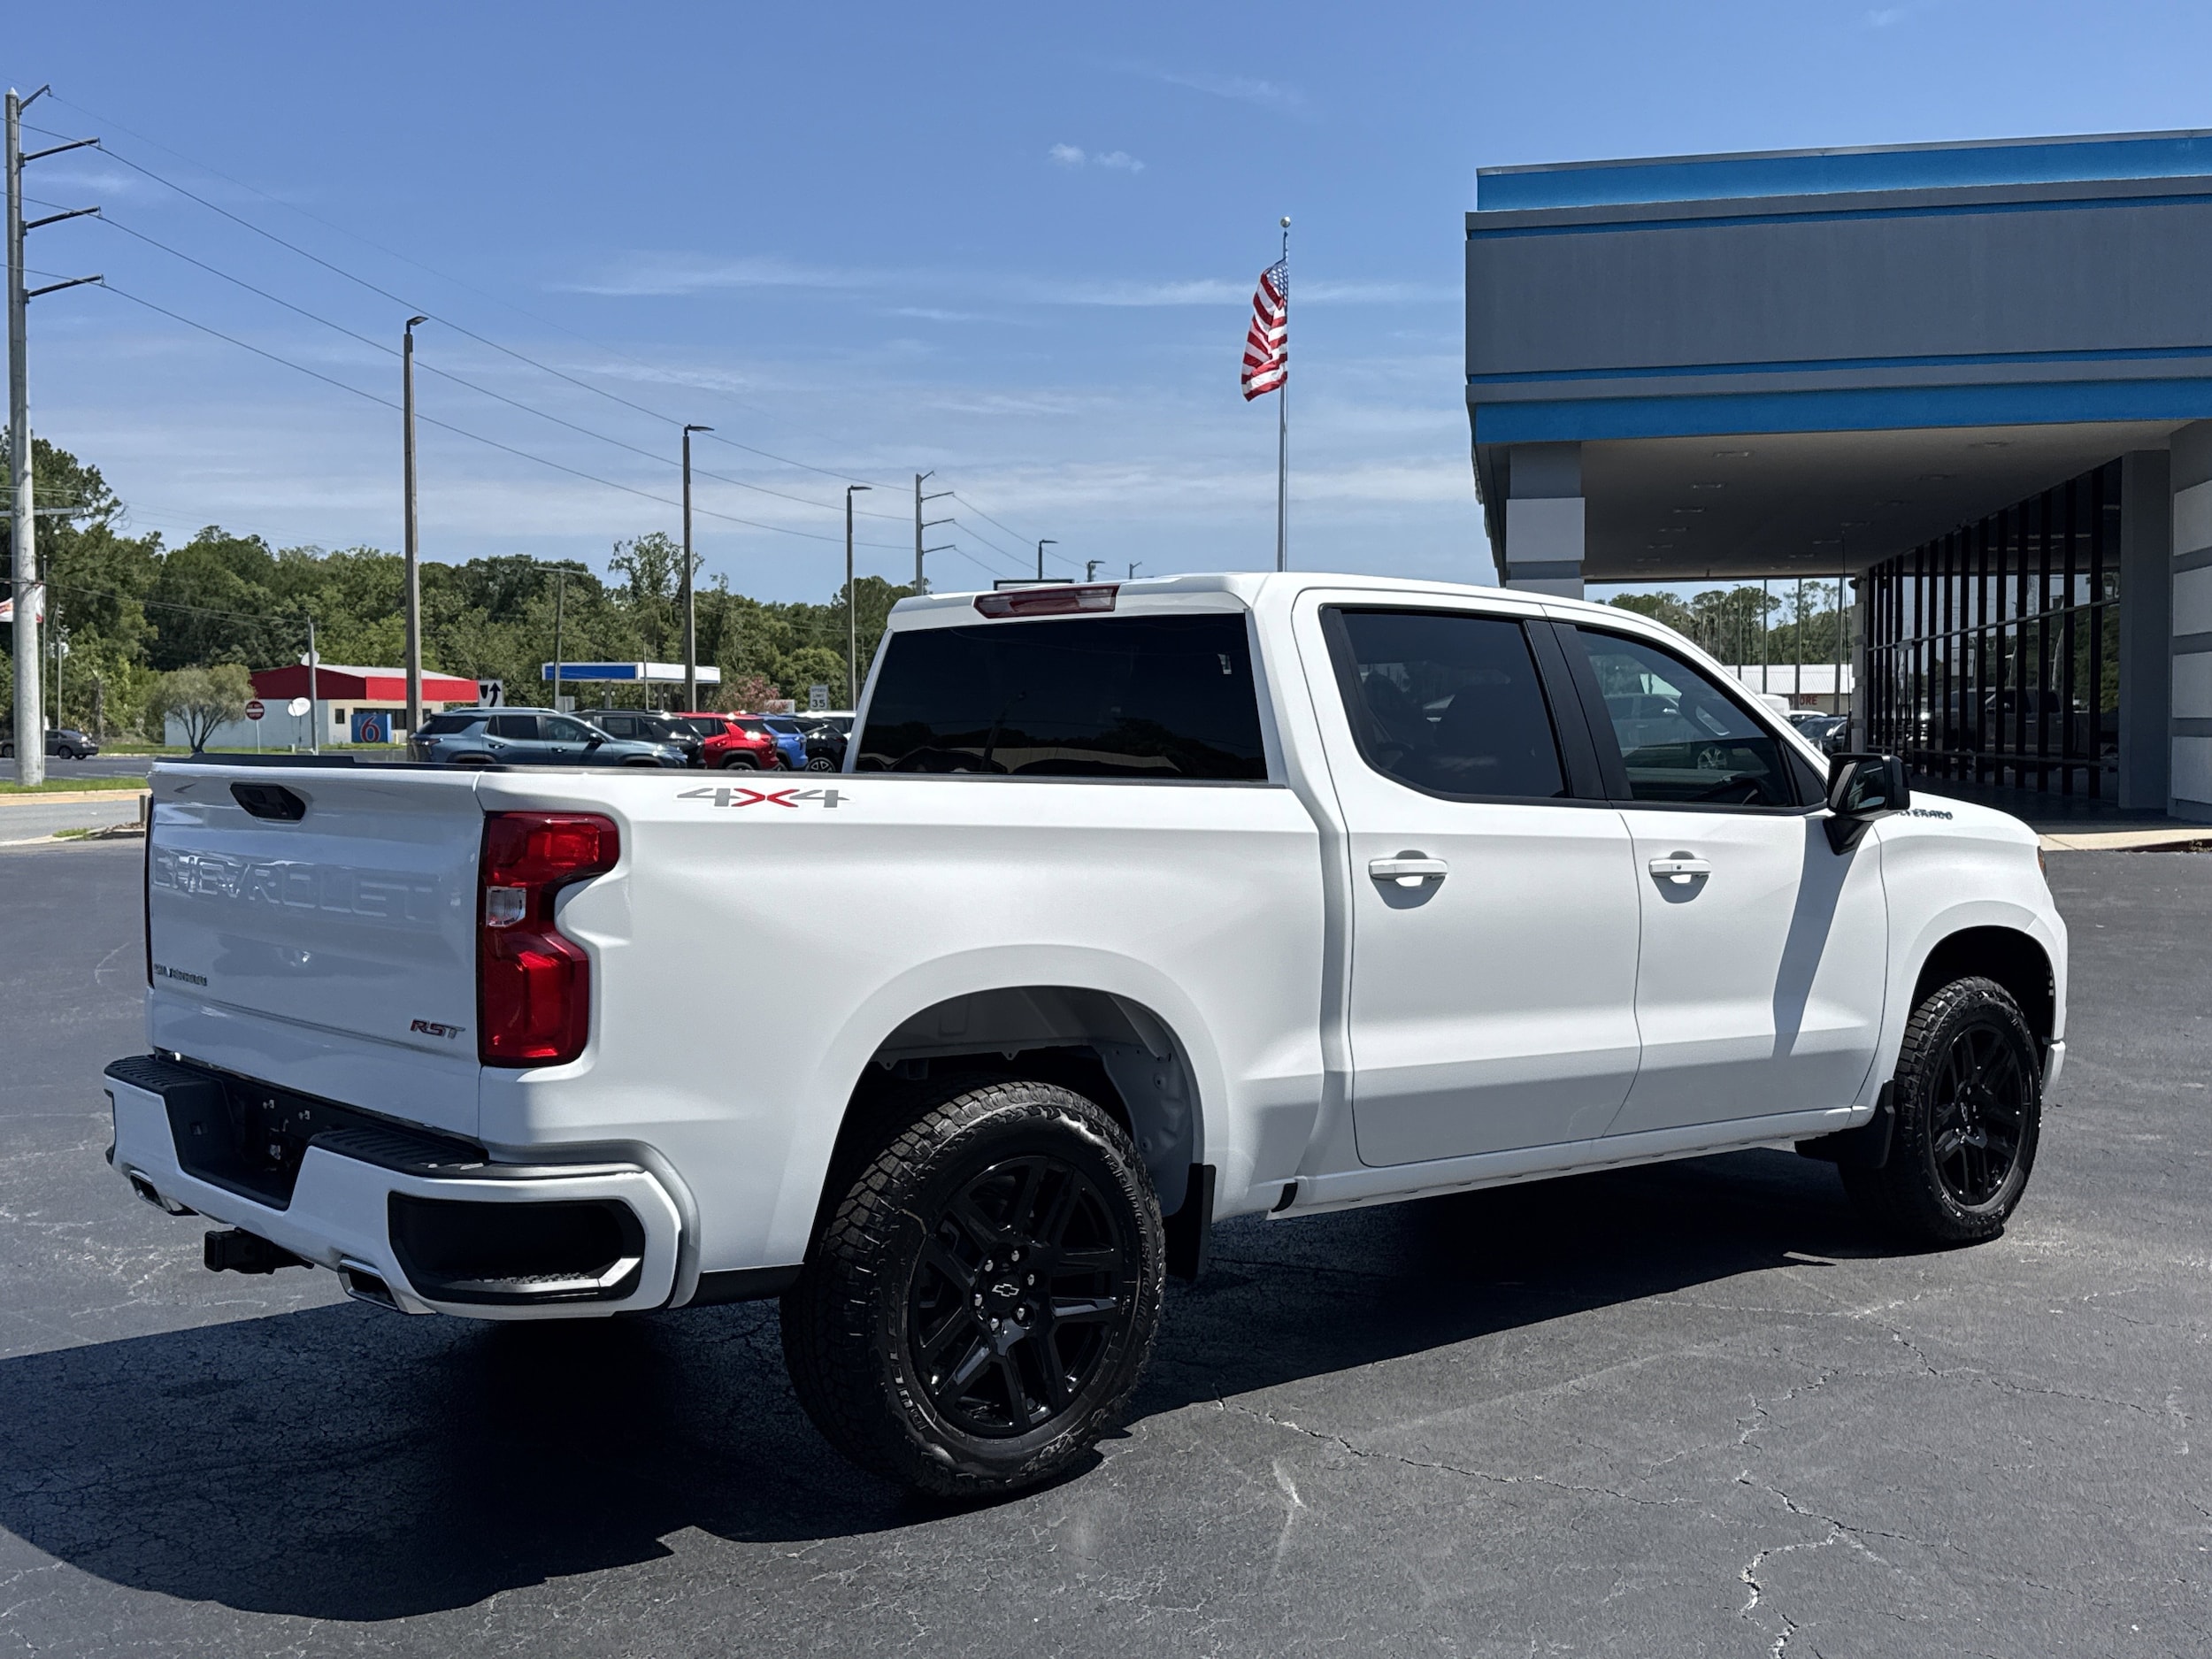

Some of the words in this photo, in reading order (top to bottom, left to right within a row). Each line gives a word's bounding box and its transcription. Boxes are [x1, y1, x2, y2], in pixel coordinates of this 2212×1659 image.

[1789, 696, 1817, 705] SORE
[360, 715, 380, 742] 6
[152, 852, 441, 920] CHEVROLET
[410, 1018, 466, 1040] RST
